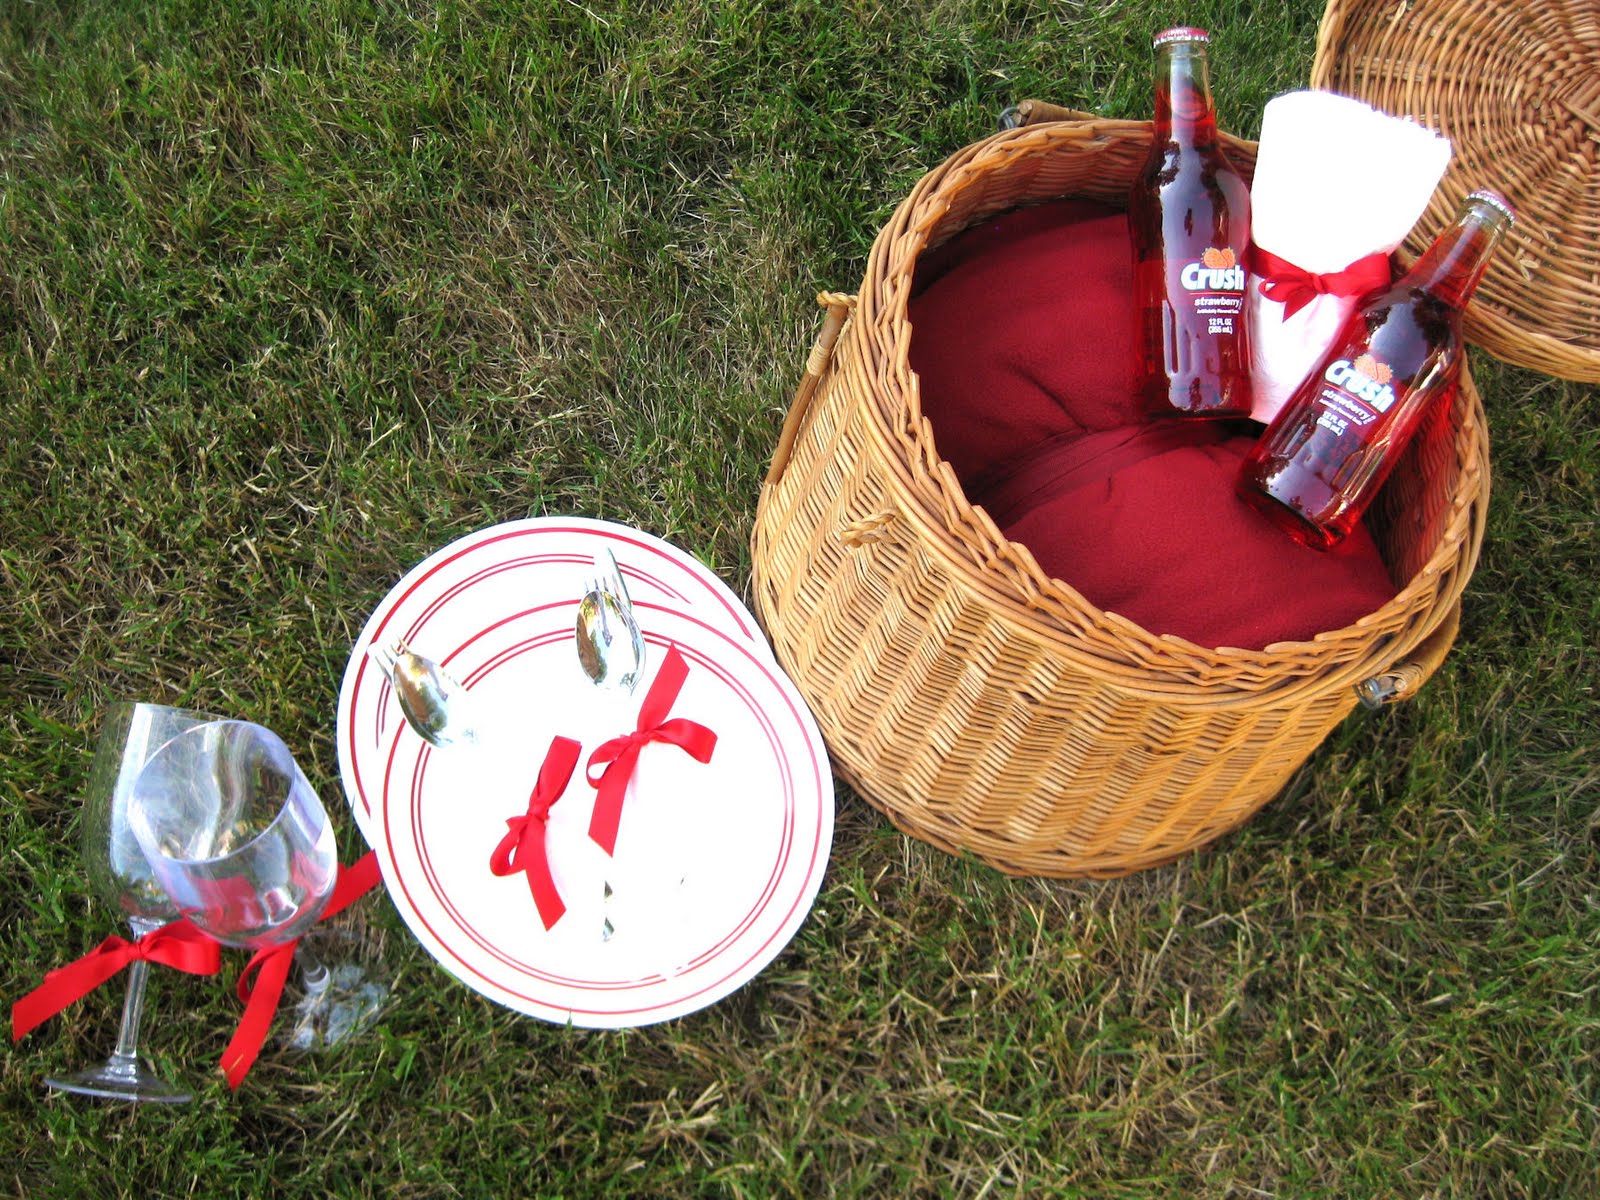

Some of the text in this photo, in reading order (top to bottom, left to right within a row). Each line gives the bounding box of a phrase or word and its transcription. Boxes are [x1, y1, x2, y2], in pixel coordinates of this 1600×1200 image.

[1181, 263, 1245, 290] Crush
[1194, 297, 1239, 307] strawberry
[1208, 318, 1216, 326] 12
[1208, 326, 1222, 335] (355
[1325, 360, 1395, 413] Crush
[1321, 390, 1371, 420] strawberry
[1322, 410, 1332, 420] 12
